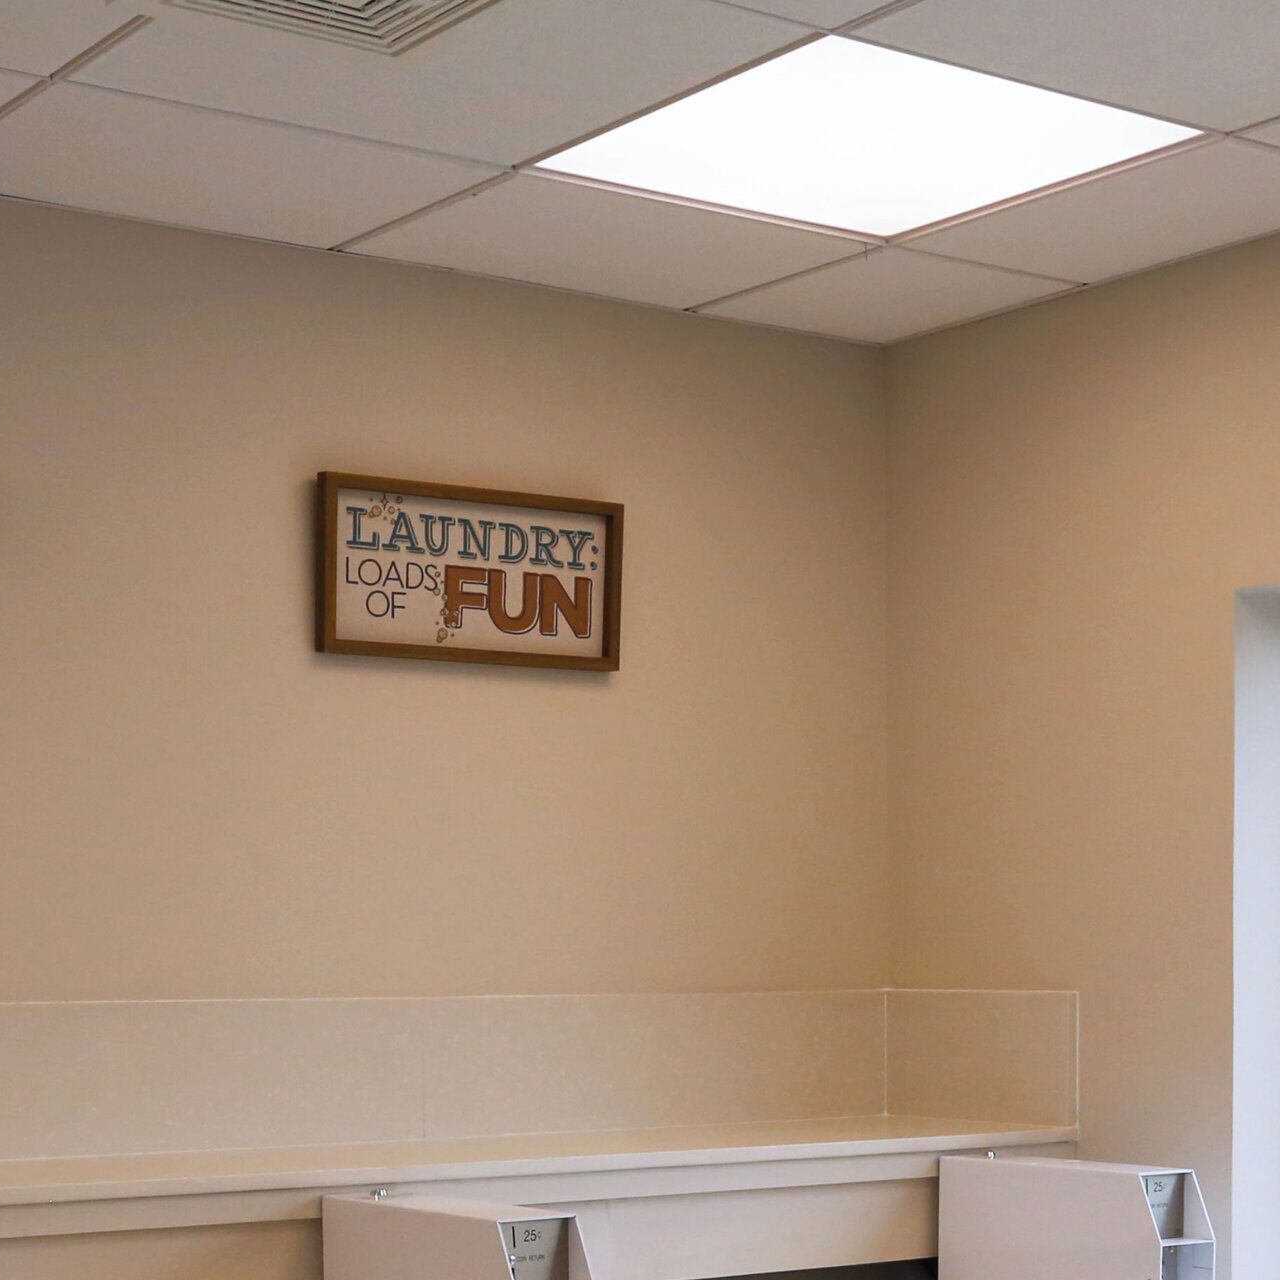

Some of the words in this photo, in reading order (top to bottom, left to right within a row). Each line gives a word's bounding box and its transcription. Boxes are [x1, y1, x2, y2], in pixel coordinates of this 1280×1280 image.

[345, 556, 438, 592] LOADS
[366, 589, 407, 619] OF
[443, 565, 593, 639] FUN
